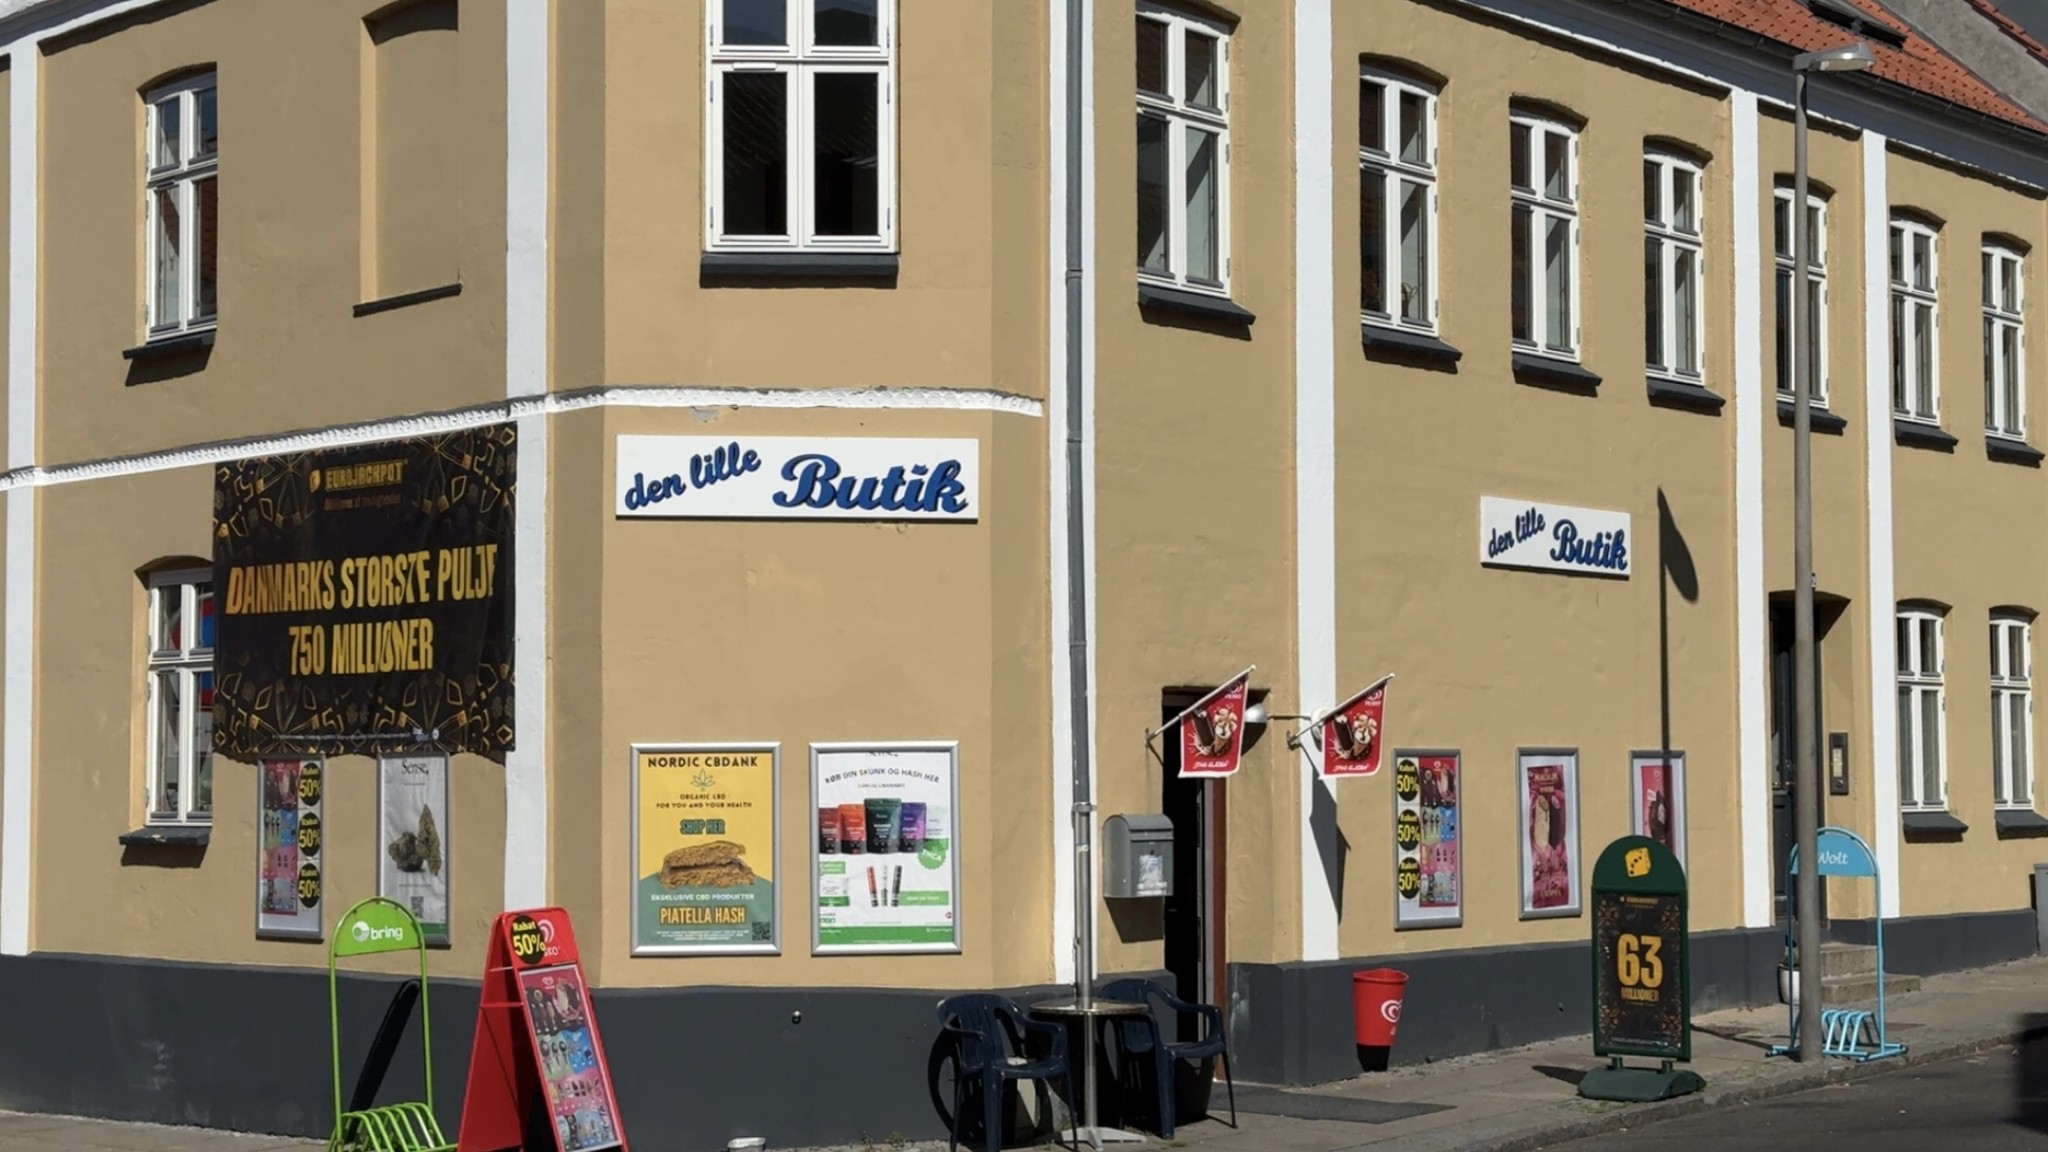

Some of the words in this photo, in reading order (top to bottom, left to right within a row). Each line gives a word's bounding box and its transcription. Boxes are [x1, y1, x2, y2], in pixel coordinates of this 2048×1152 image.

[624, 472, 686, 511] den
[690, 441, 761, 489] lille
[772, 453, 969, 514] Butik
[1488, 527, 1515, 558] den
[1516, 507, 1546, 543] lille
[1550, 518, 1628, 571] Butik
[225, 559, 336, 615] DANMARKS
[340, 550, 431, 609] STØRSTE
[289, 624, 326, 676] 750
[648, 756, 700, 768] NORDIC
[705, 756, 758, 768] CBDANK
[843, 770, 858, 780] DIN
[859, 767, 886, 776] SKUNK
[887, 767, 900, 775] OG
[901, 769, 923, 779] HASH
[924, 773, 940, 783] HER
[1397, 774, 1420, 792] 50%
[1398, 825, 1420, 842] 50%
[695, 893, 711, 901] CBD
[660, 906, 712, 924] PIATELLA
[715, 906, 746, 924] HASH
[371, 925, 403, 941] bring
[512, 920, 537, 932] Rabat
[513, 933, 546, 956] 50%
[1617, 933, 1663, 989] 63
